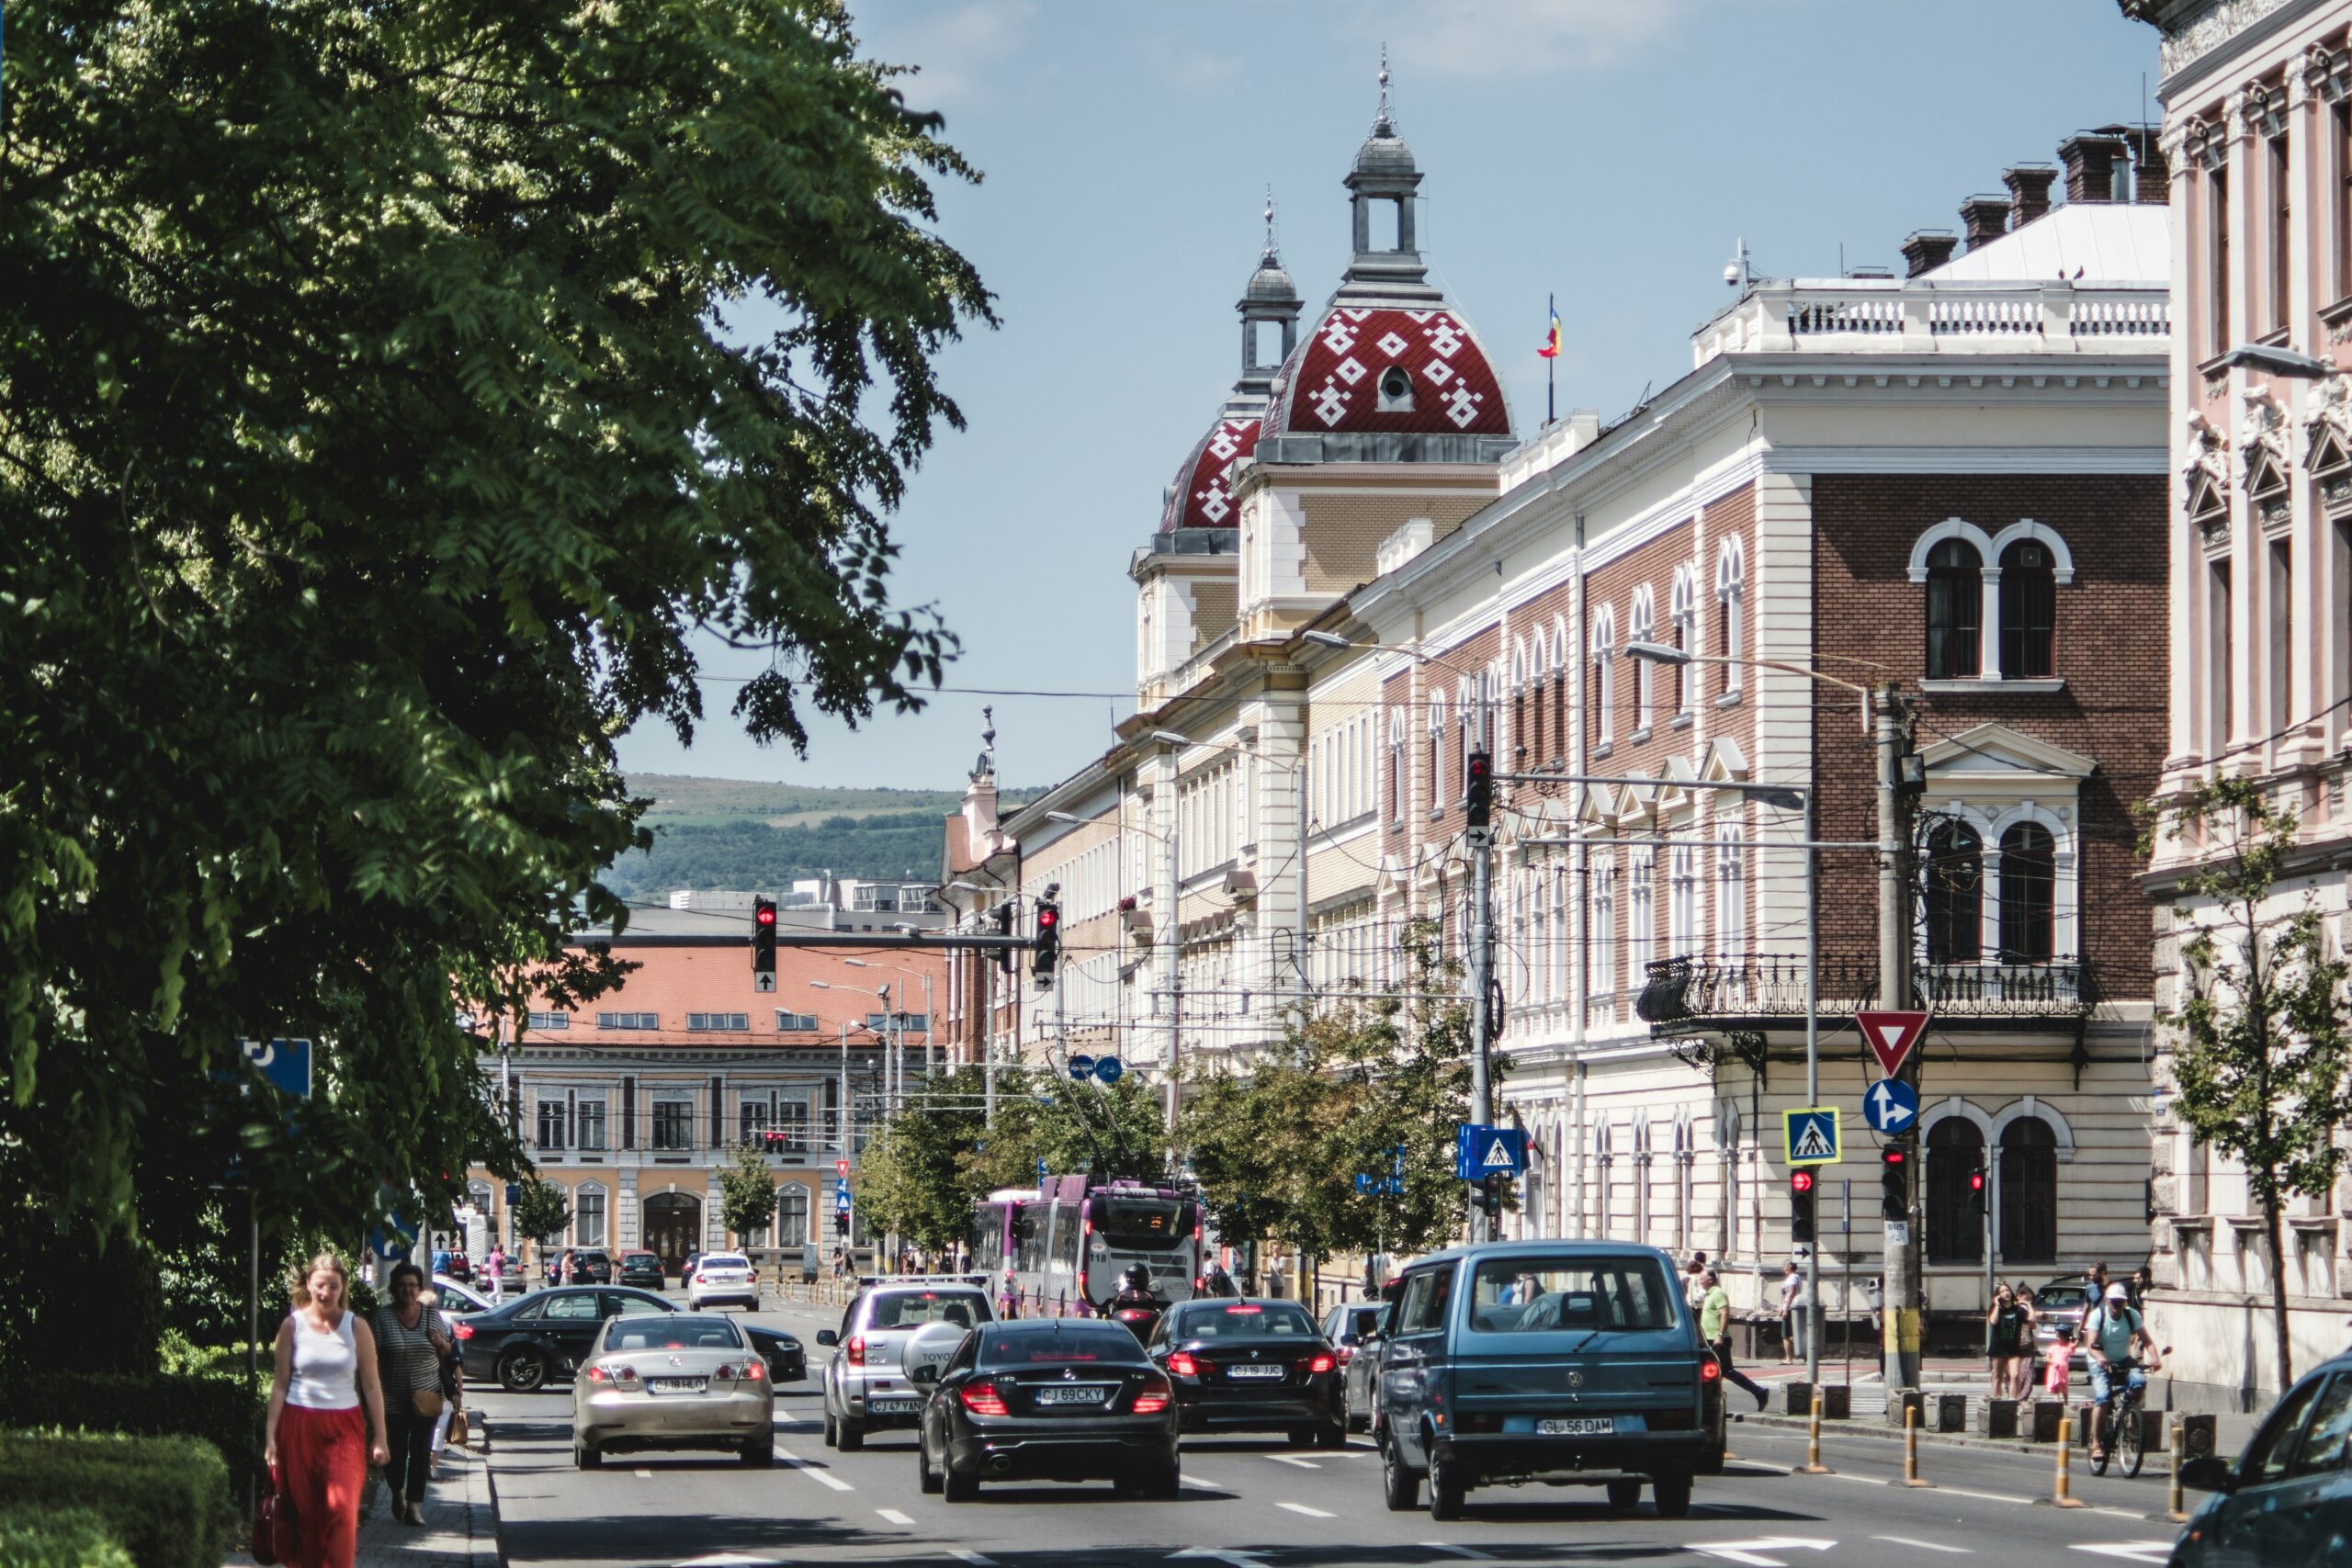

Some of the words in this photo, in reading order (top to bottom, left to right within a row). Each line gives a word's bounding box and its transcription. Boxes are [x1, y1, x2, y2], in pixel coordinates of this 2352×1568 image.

[1089, 1254, 1107, 1263] 118
[655, 1380, 668, 1391] CJ
[874, 1402, 888, 1412] CJ
[889, 1402, 899, 1411] 47
